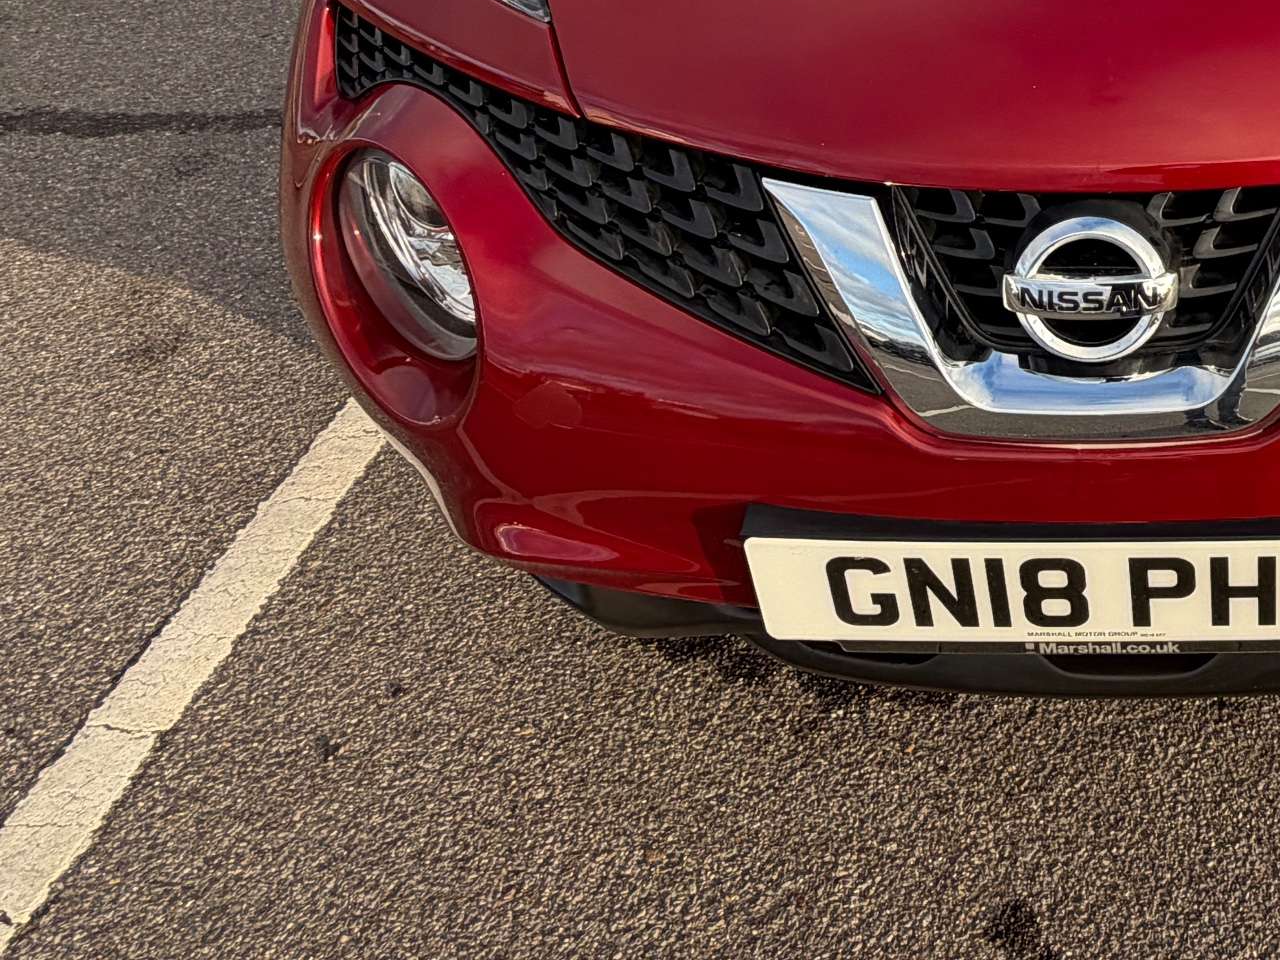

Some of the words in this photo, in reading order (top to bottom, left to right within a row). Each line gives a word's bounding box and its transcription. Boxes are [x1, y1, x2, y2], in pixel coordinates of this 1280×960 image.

[1020, 285, 1158, 313] NISSAN
[825, 556, 1090, 627] GN18
[1039, 642, 1180, 655] Marshall.co.uk
